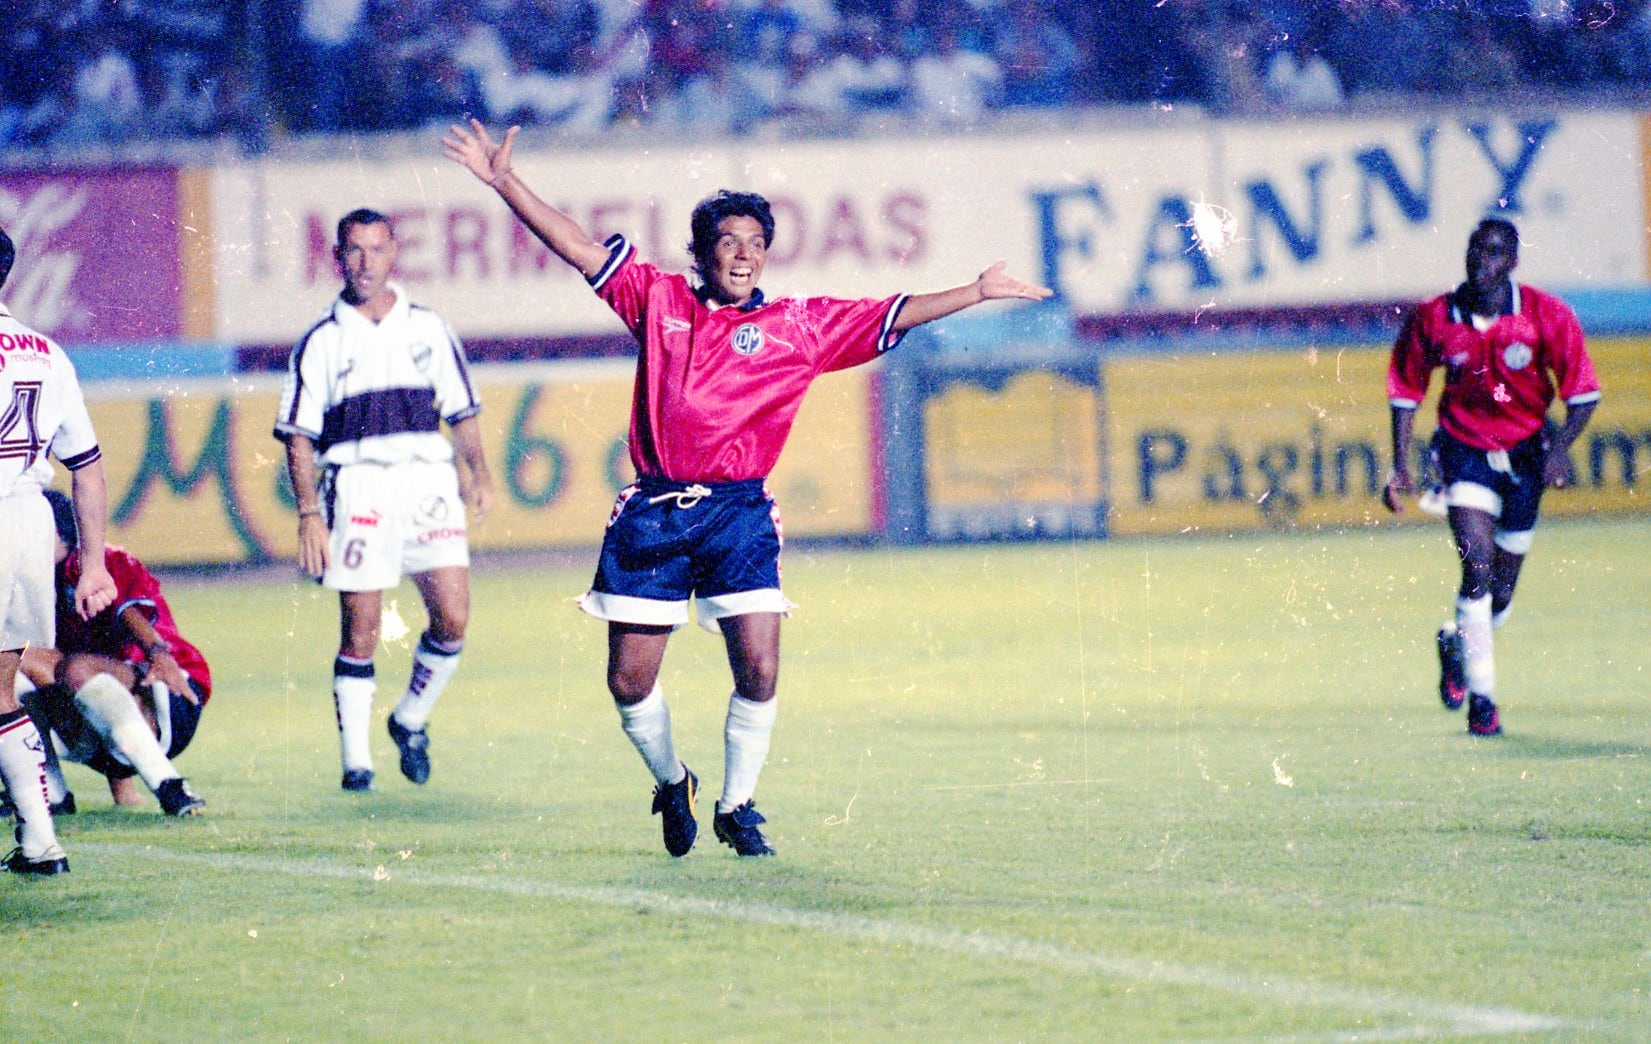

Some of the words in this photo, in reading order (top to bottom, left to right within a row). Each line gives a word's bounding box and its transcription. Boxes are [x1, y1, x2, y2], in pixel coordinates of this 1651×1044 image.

[1024, 116, 1558, 306] FANNY
[0, 380, 47, 476] 4
[343, 538, 366, 570] 6
